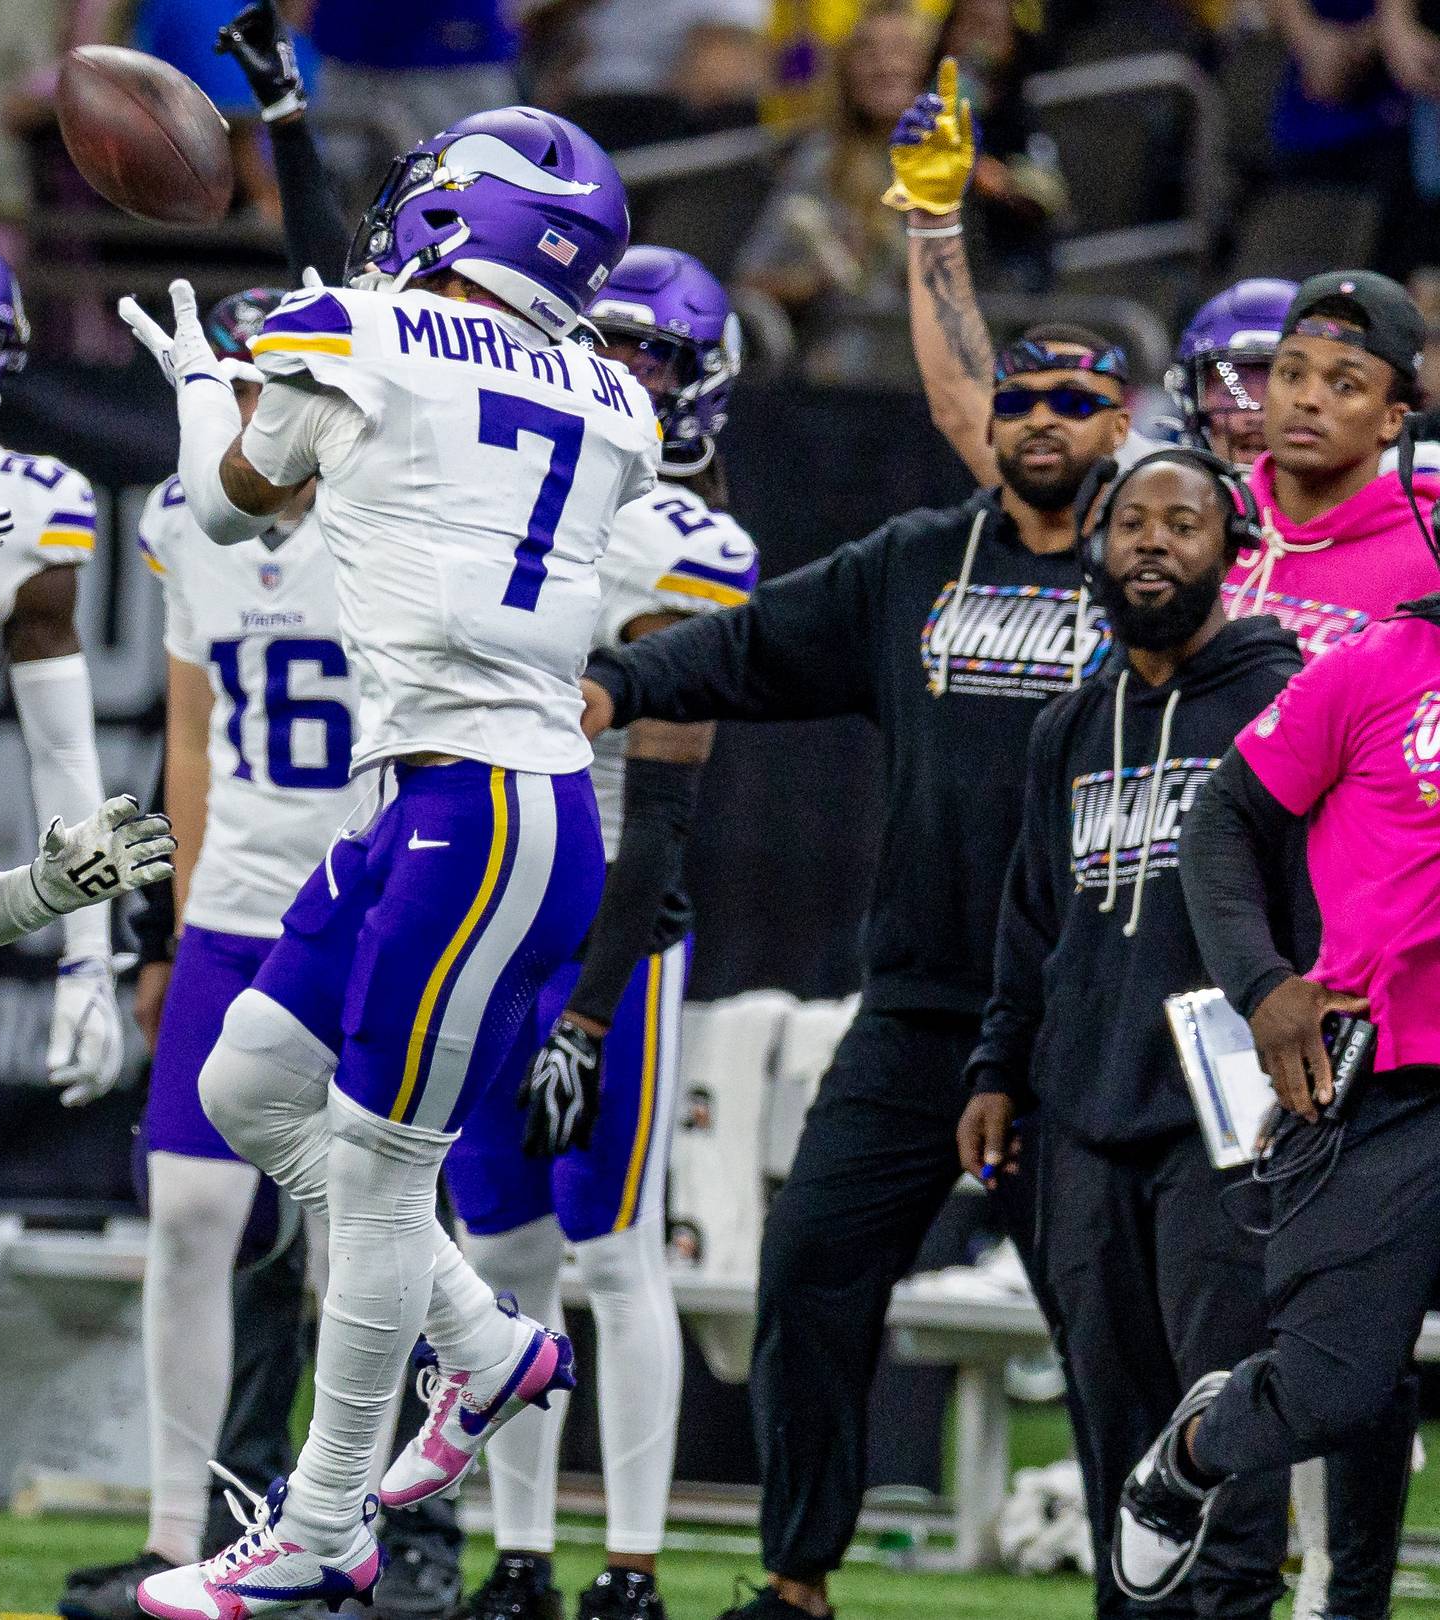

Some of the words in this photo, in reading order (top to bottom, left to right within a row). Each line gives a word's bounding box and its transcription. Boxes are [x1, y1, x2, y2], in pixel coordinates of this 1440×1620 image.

[393, 306, 574, 392] MURPHY
[587, 357, 633, 417] JR
[477, 388, 585, 612] 7
[210, 638, 352, 790] 16
[67, 850, 120, 898] 12
